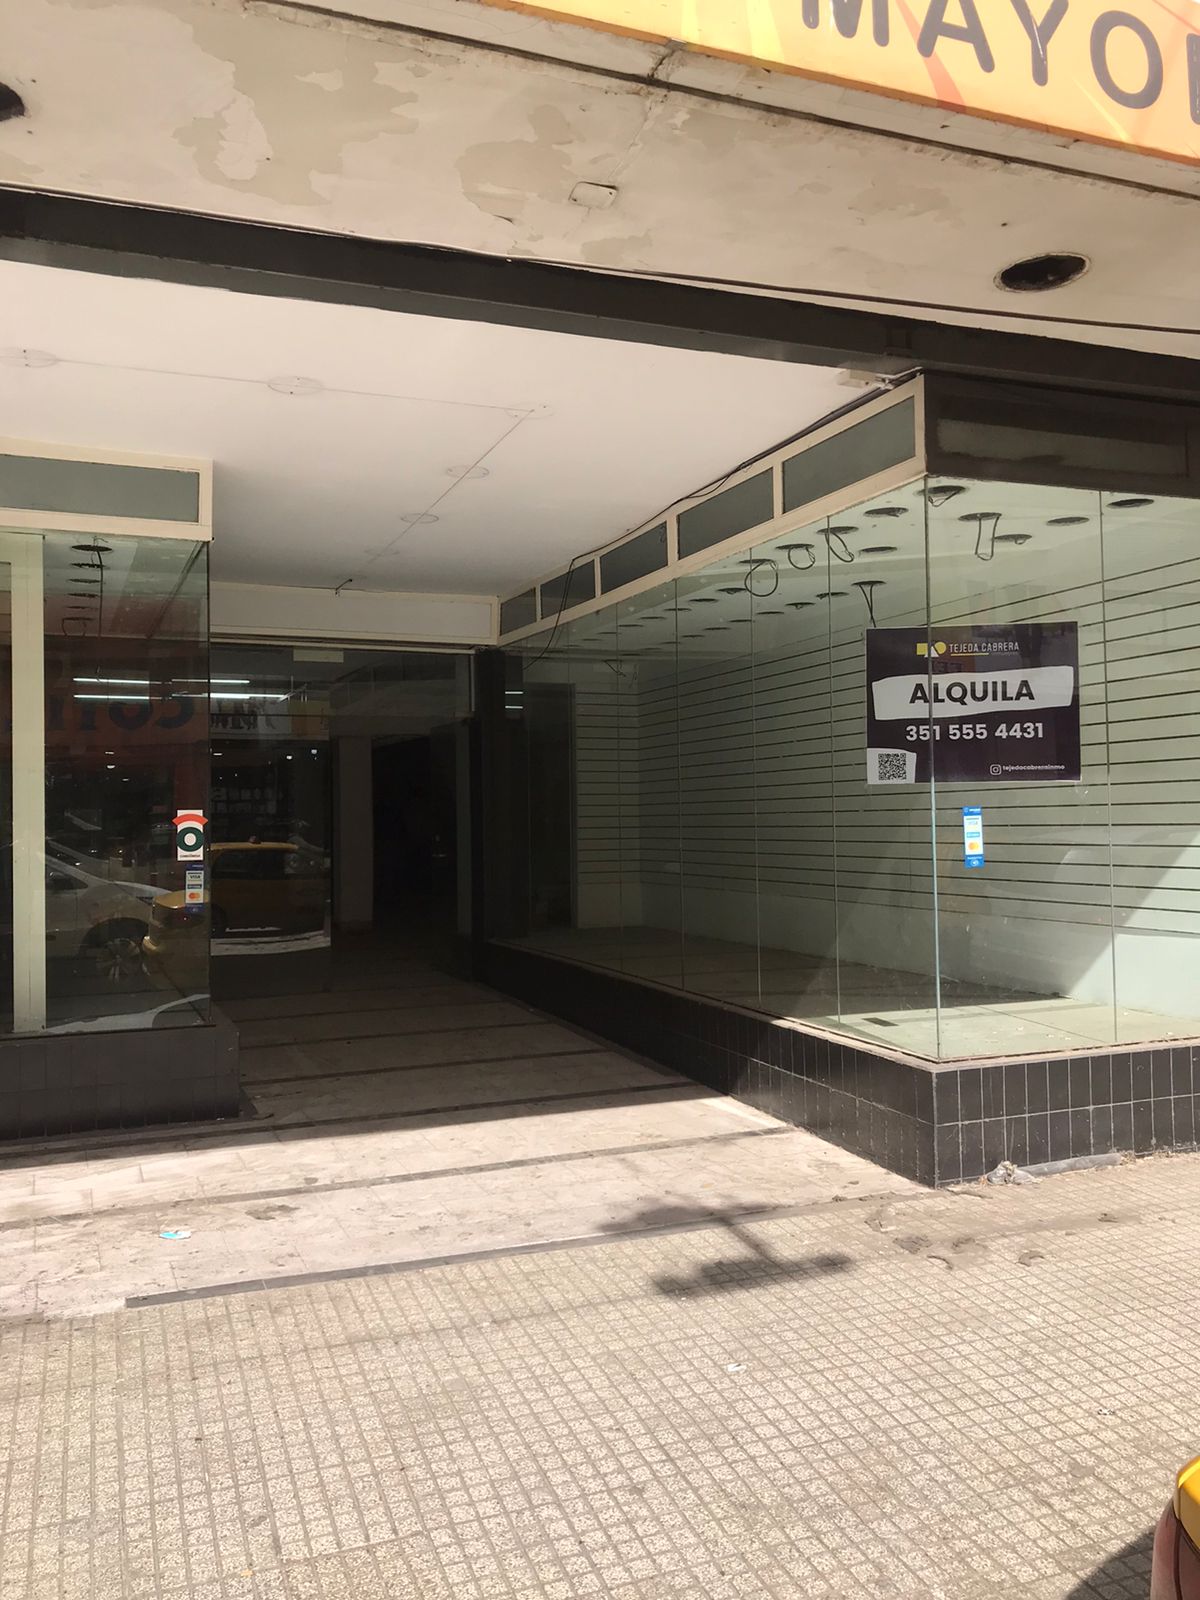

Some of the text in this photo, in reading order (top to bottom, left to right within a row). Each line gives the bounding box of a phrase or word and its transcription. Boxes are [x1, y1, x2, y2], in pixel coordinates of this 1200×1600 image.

[801, 0, 1200, 126] AYO
[949, 641, 1019, 653] TEJEDA CABRERA
[909, 680, 1035, 705] ALQUILA
[905, 722, 1044, 741] 351 555 4431
